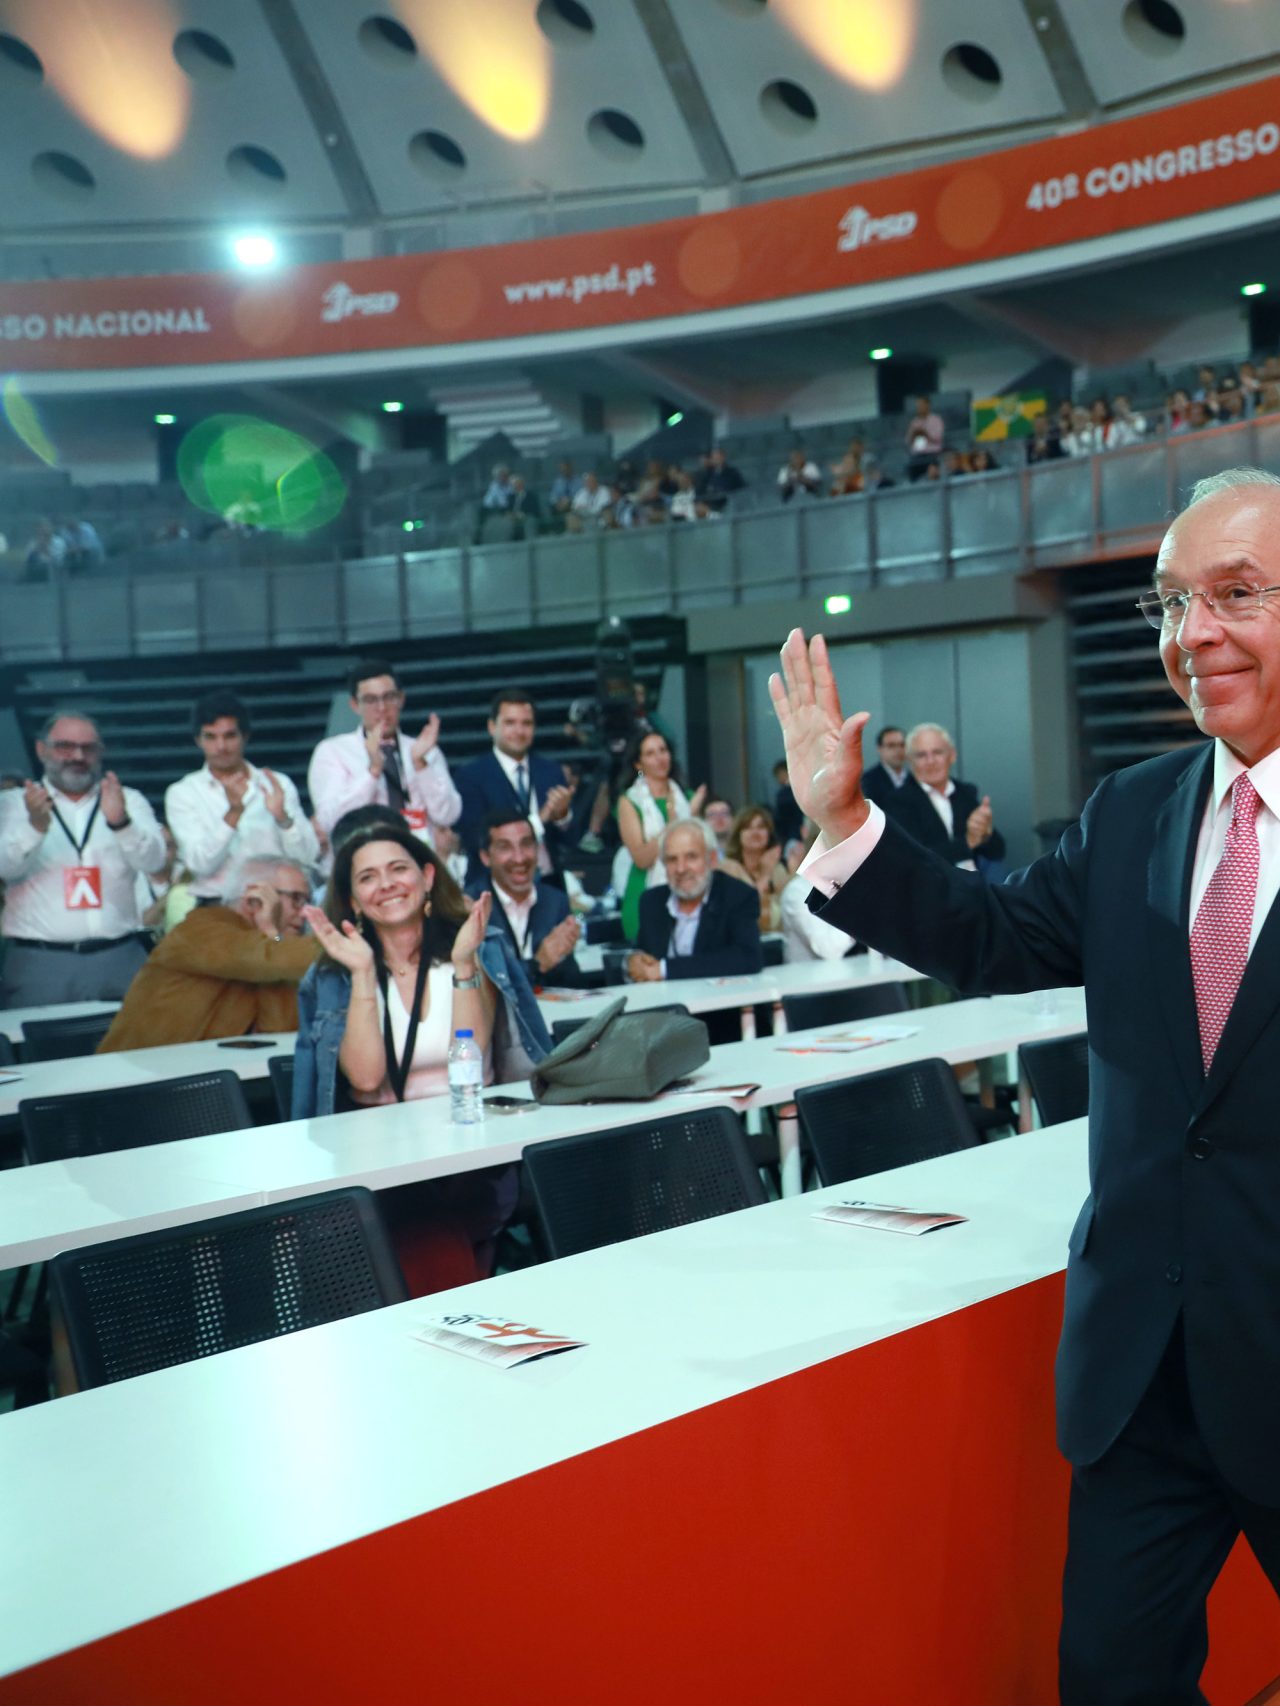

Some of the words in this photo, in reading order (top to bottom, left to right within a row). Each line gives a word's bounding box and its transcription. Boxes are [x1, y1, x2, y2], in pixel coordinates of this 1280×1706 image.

[1085, 122, 1280, 197] CONGRESSO
[862, 210, 918, 245] PSD
[504, 261, 655, 304] www.psd.pt
[343, 291, 399, 317] PSD
[54, 307, 210, 339] NACIONAL
